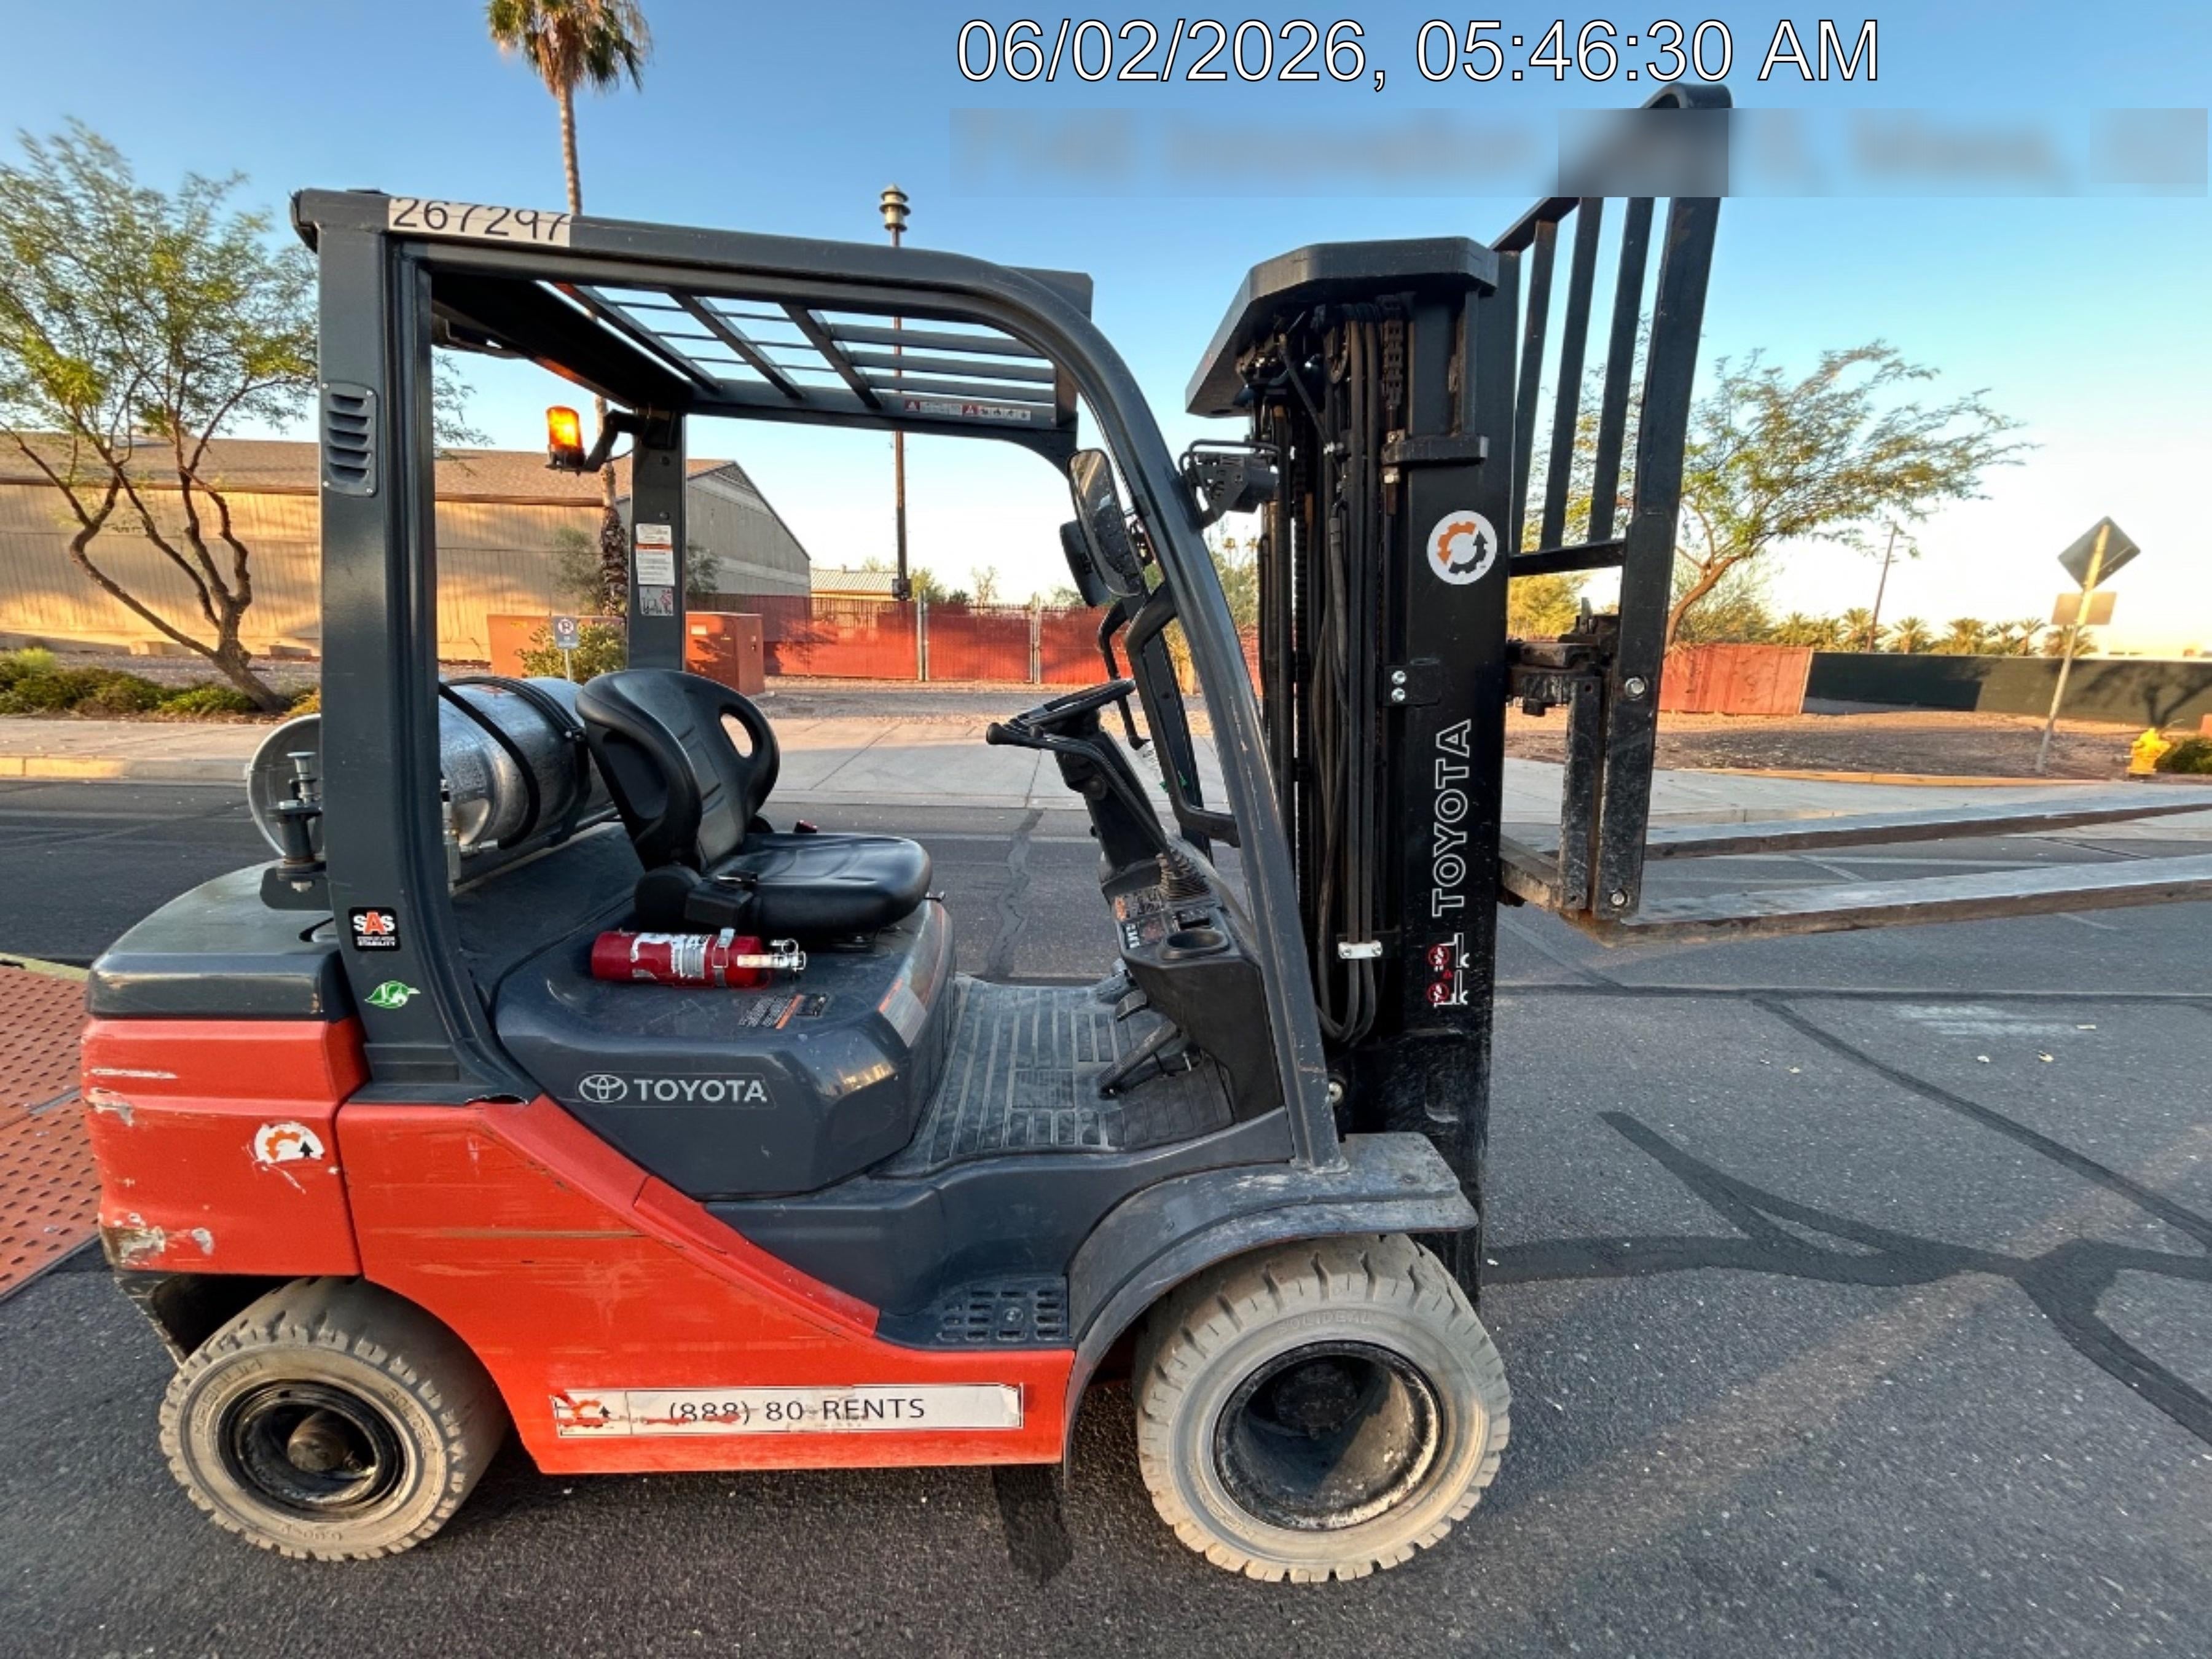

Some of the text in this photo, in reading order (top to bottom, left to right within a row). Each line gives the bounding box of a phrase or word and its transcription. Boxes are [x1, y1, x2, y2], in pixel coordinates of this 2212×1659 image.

[393, 197, 570, 241] 267297
[1432, 719, 1472, 917] TOYOTA
[353, 912, 396, 935] SAS
[633, 1079, 767, 1102] TOYOTA
[669, 1398, 925, 1426] (888) 80 RENTS
